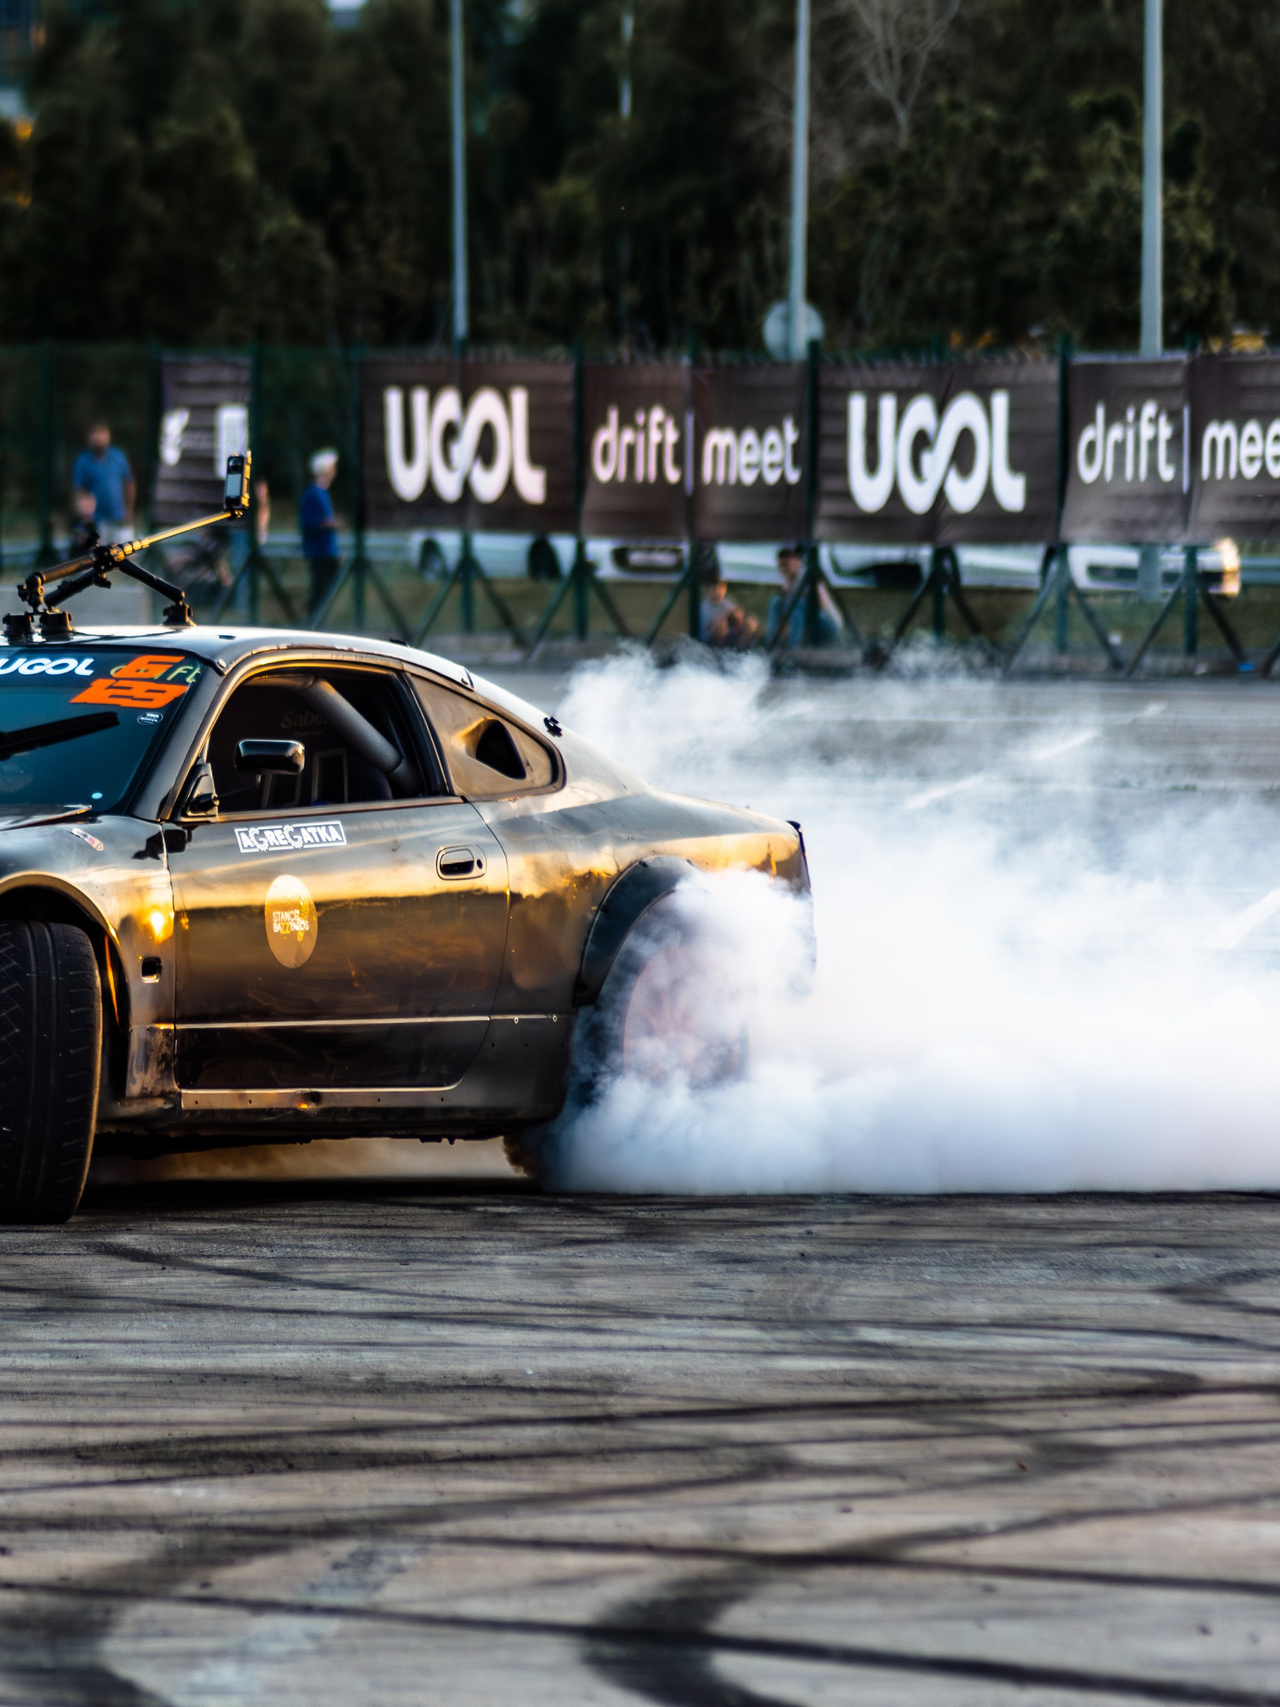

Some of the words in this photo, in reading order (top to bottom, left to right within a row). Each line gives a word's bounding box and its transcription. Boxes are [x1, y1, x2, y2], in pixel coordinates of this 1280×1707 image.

[383, 385, 547, 504] UGOL
[591, 405, 681, 485] drift
[701, 414, 802, 486] meet
[847, 389, 1026, 515] UGOL
[1077, 400, 1176, 484] drift
[1201, 419, 1280, 480] mee
[239, 824, 342, 851] AGREGATKA
